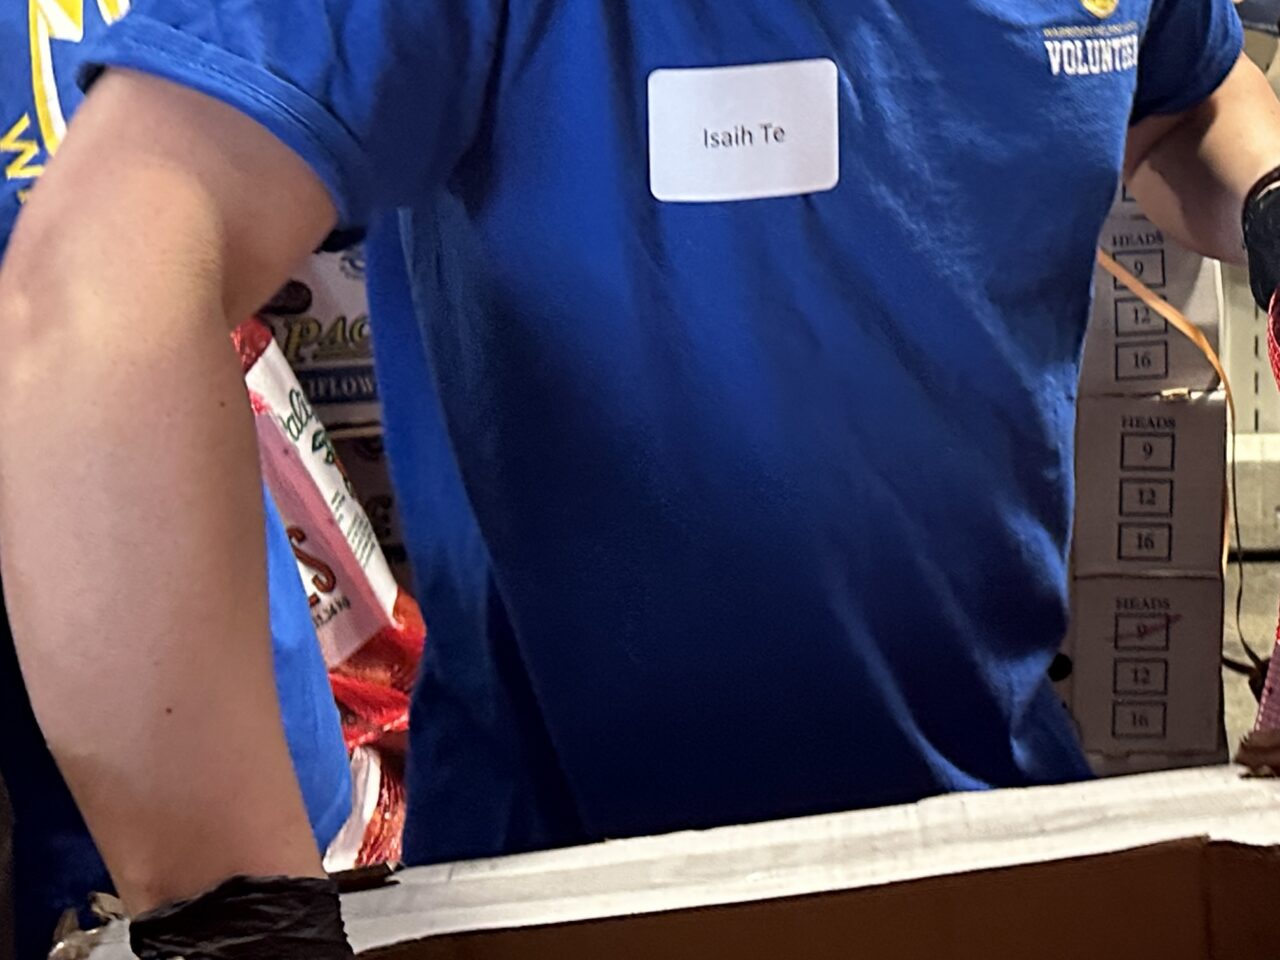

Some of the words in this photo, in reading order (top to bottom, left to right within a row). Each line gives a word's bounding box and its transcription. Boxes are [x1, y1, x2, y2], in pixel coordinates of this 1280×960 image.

[703, 125, 753, 149] Isaih
[760, 123, 785, 144] Te
[1134, 260, 1144, 277] 9
[1133, 351, 1152, 370] 16
[1121, 415, 1176, 429] HEADS
[1142, 442, 1153, 461] 9
[1138, 487, 1157, 506] 12
[1136, 532, 1155, 551] 16
[1115, 596, 1171, 611] HEADS
[1132, 666, 1151, 685] 12
